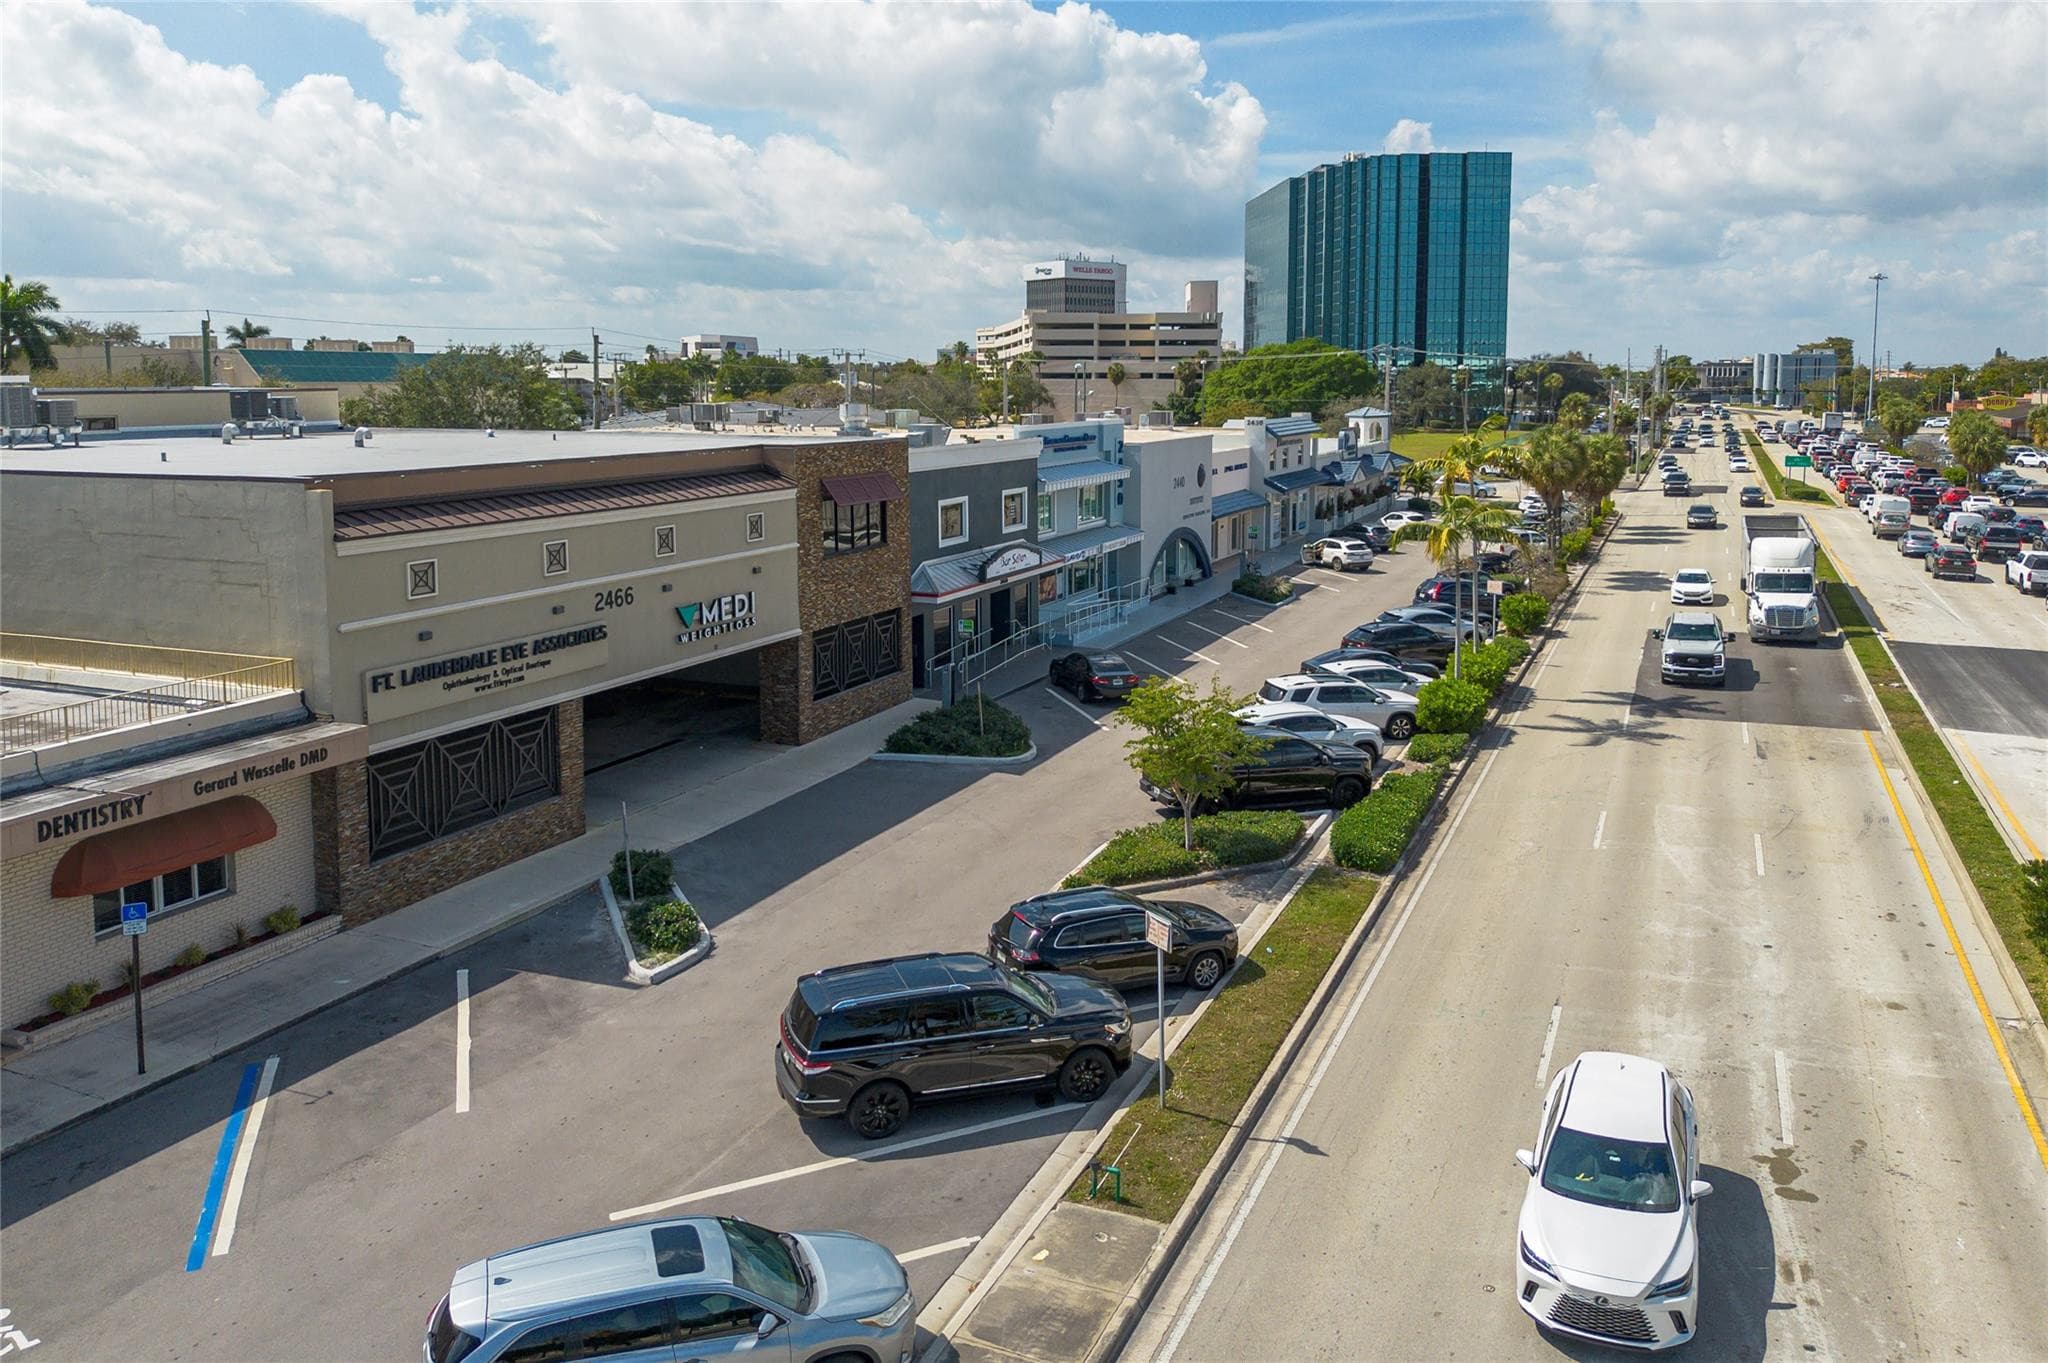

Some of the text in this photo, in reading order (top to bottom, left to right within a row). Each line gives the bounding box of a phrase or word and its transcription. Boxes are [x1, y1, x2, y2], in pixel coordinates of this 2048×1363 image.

[594, 586, 634, 612] 2466
[700, 591, 756, 625] MEDI
[679, 616, 758, 644] WEIGHTLOSS
[371, 625, 608, 693] FT. LAUDERDALE EYE ASSOCIATES
[493, 670, 500, 678] &
[501, 664, 524, 676] Optical
[525, 659, 552, 671] Boutique
[193, 747, 329, 796] Gerard Wasselle DMD
[37, 795, 146, 843] DENTISTRY
